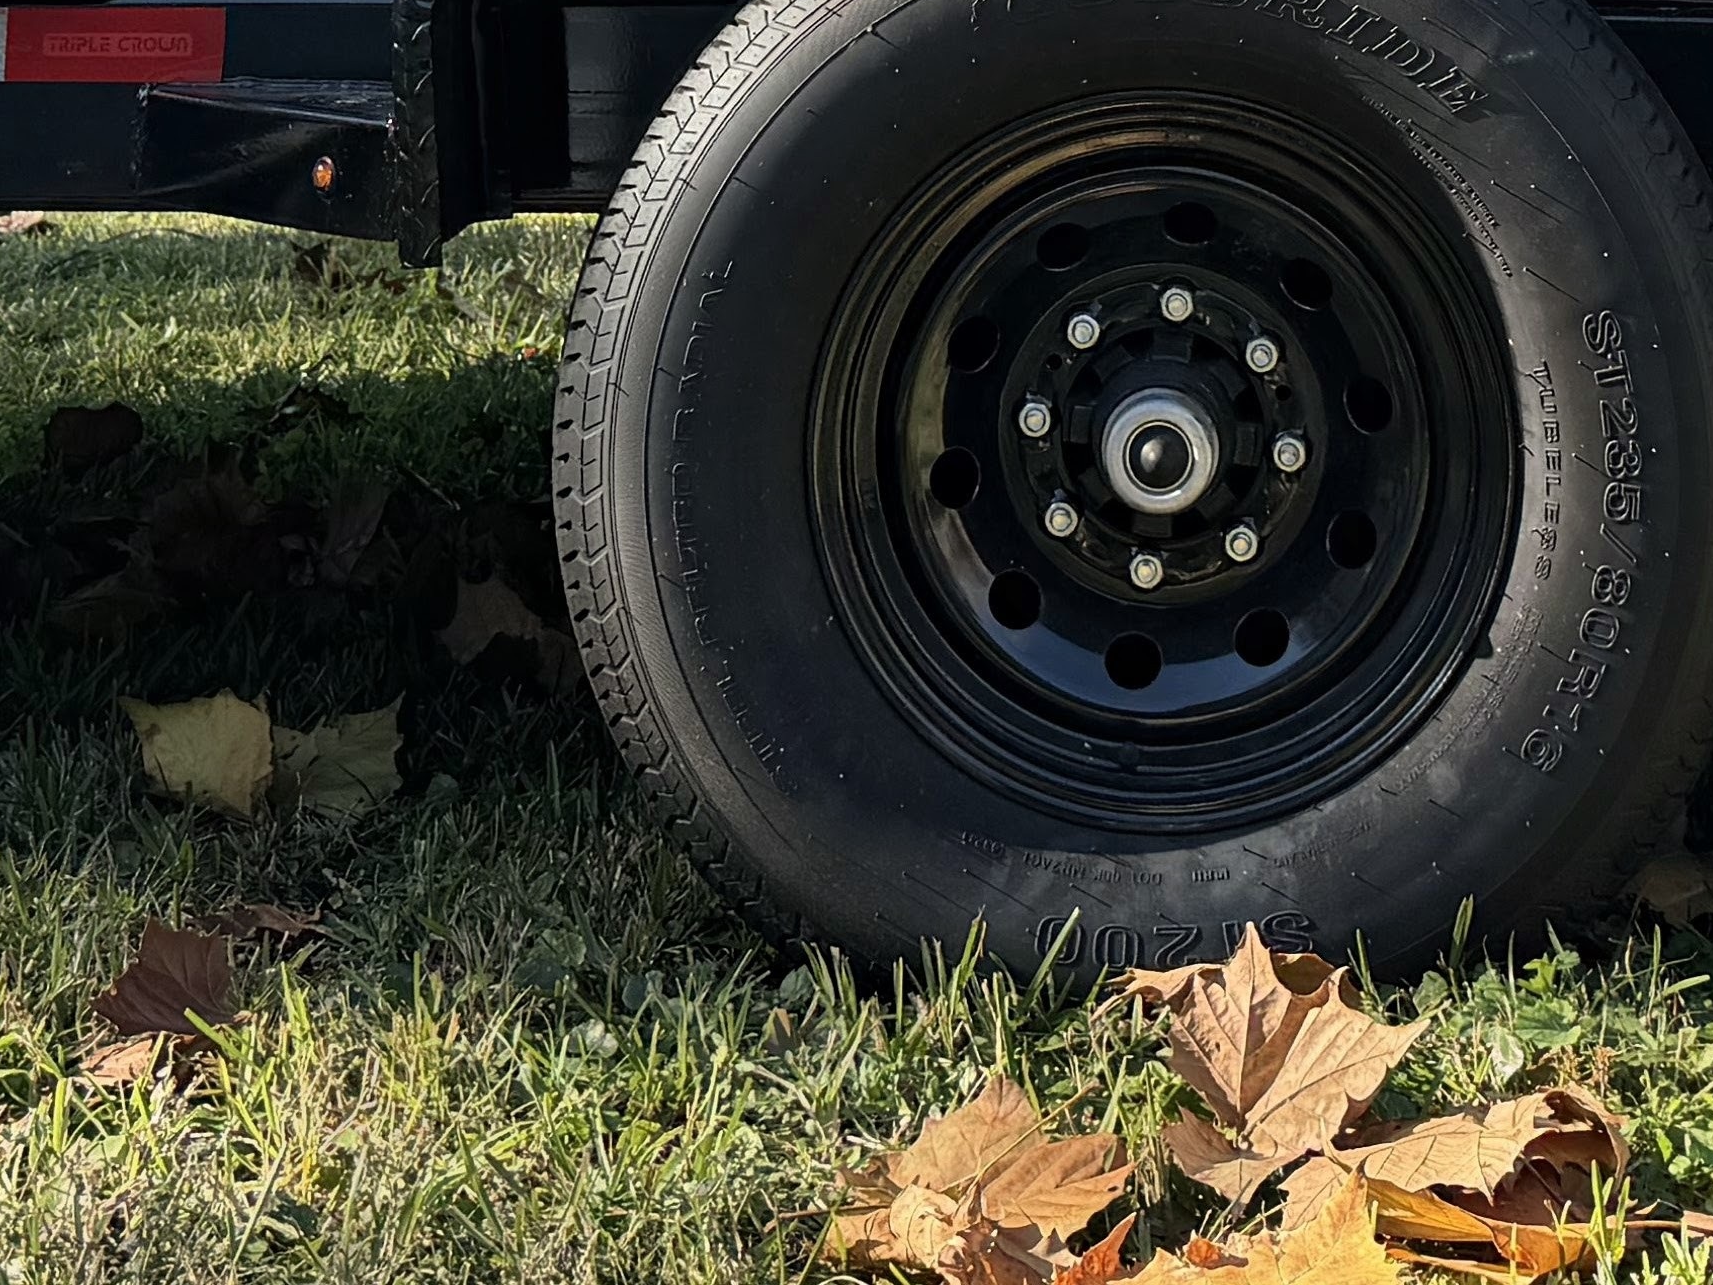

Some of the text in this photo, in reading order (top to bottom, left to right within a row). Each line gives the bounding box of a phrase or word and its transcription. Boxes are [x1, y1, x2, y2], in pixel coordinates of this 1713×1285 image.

[48, 36, 189, 54] TRIPLE CROWN
[1521, 309, 1643, 773] ST235/80R16
[1530, 359, 1563, 582] TUBELESS
